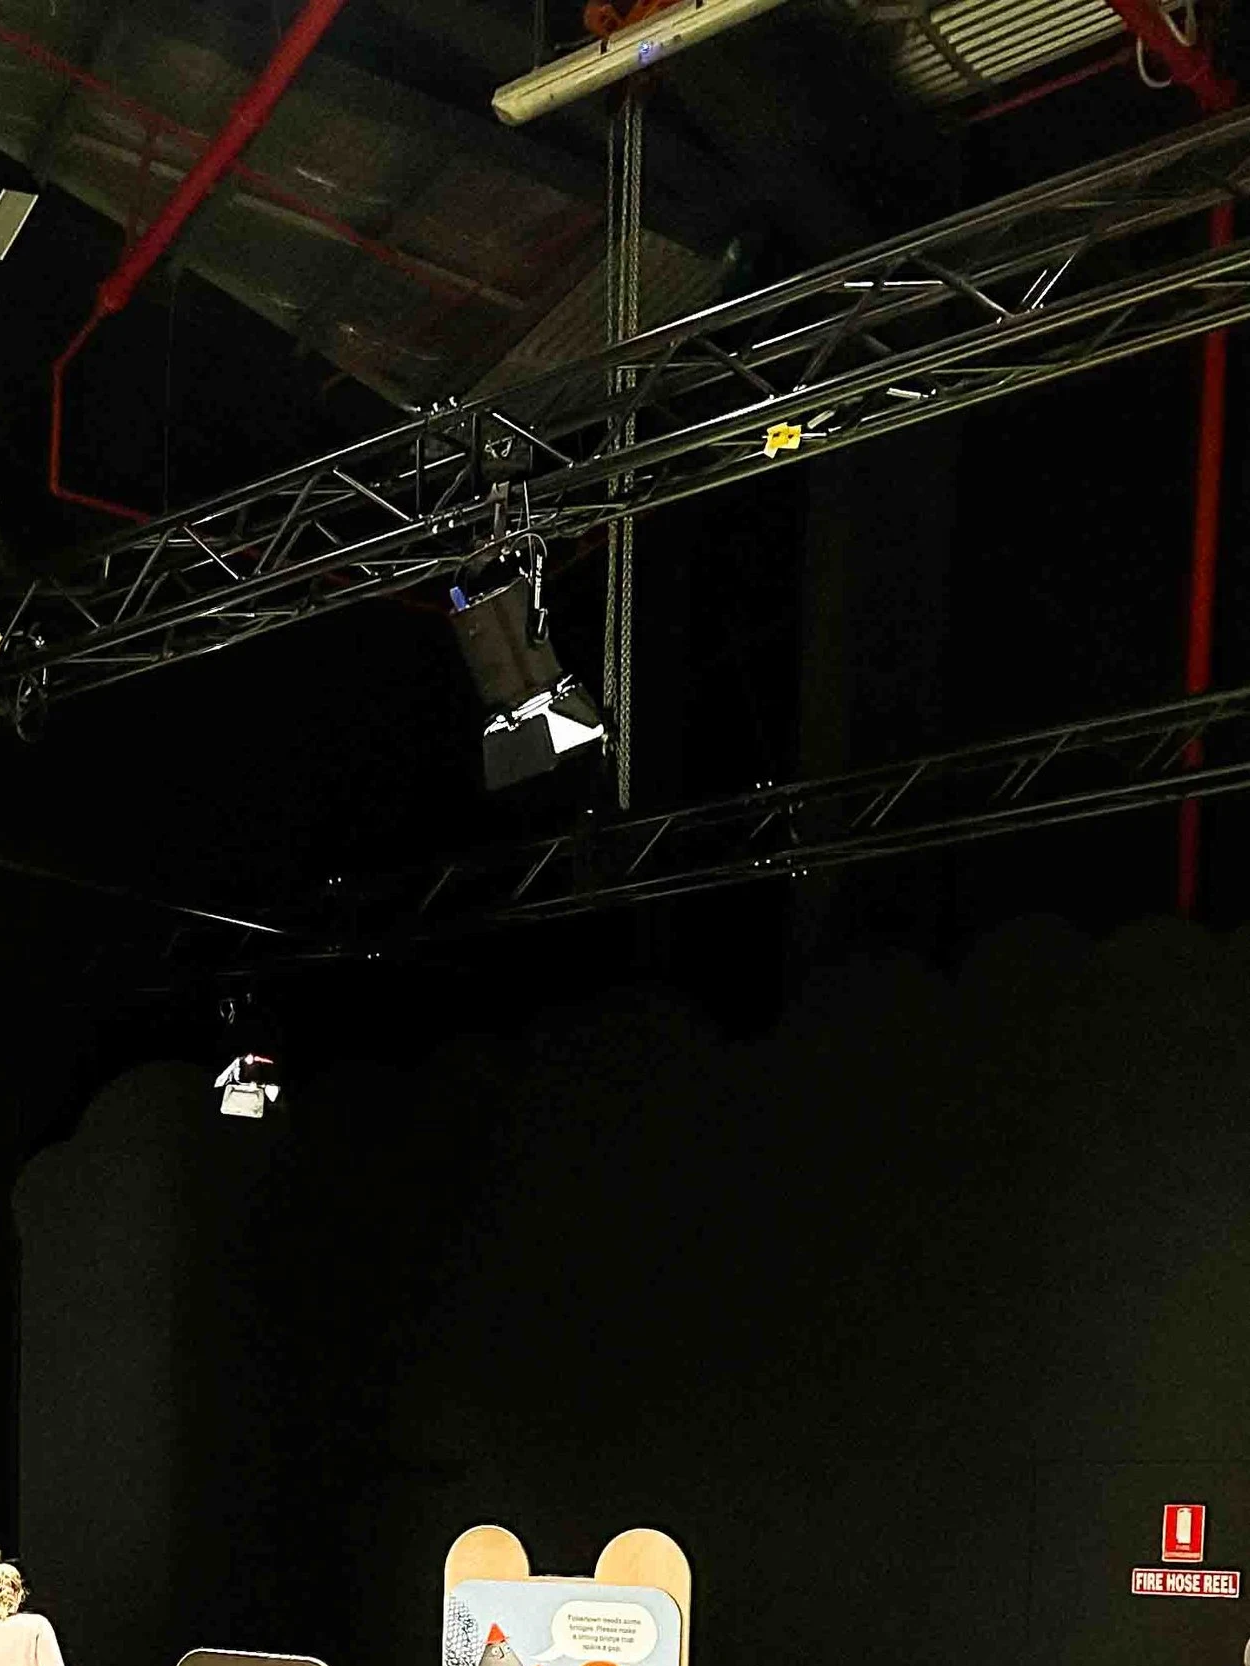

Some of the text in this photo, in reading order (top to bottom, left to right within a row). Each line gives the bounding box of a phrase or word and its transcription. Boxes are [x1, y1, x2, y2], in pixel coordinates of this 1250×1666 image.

[1135, 1572, 1236, 1594] FIRE HOSE REEL
[596, 1625, 617, 1633] Please
